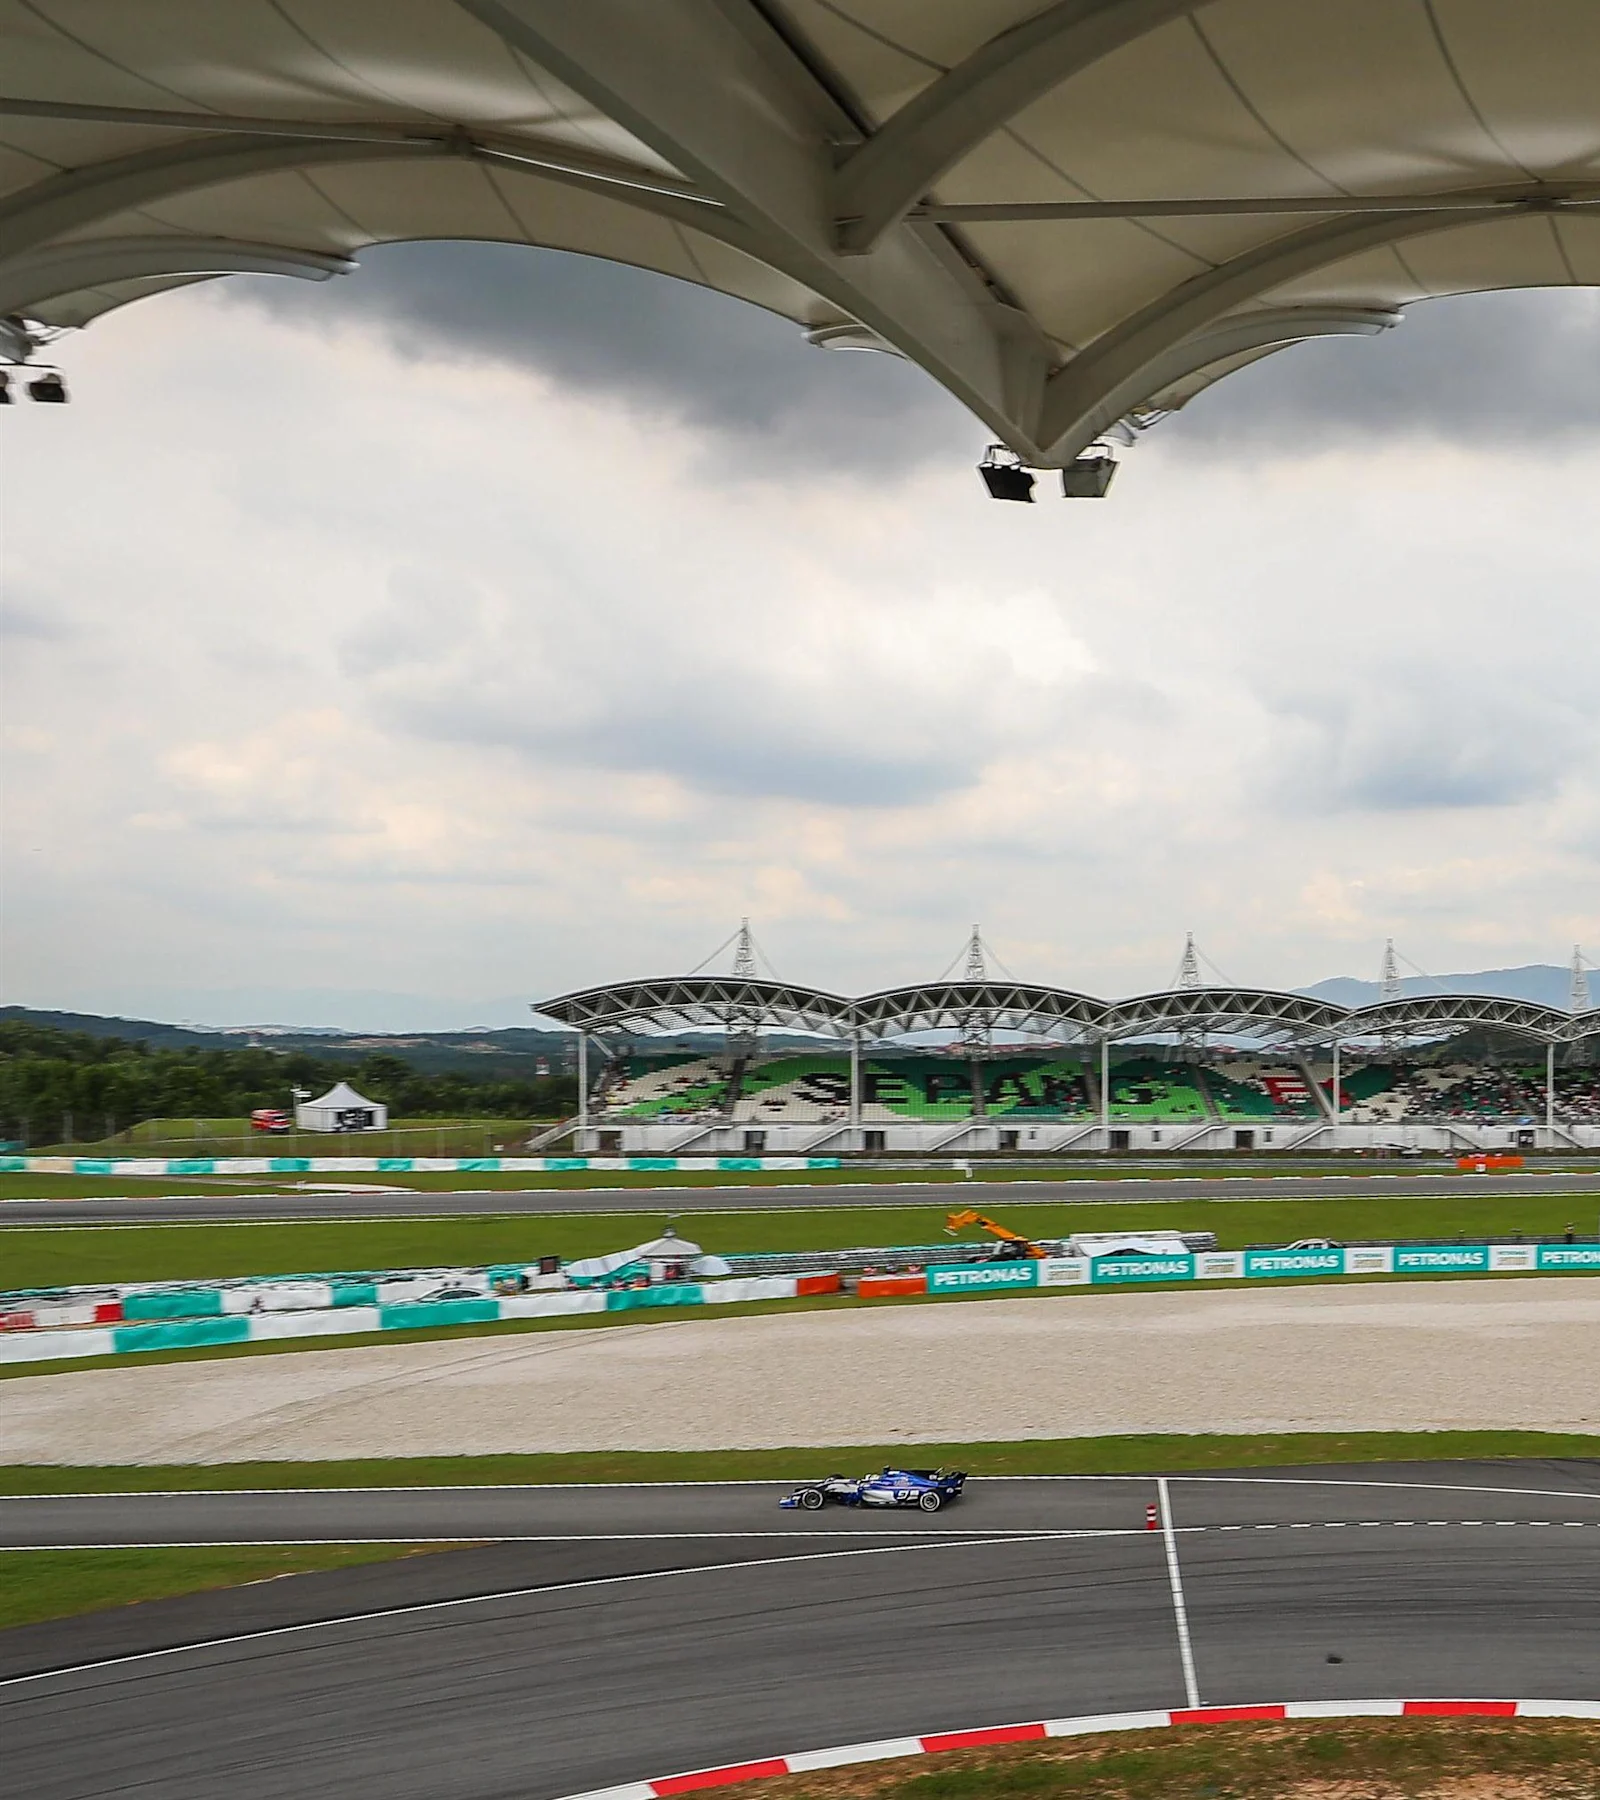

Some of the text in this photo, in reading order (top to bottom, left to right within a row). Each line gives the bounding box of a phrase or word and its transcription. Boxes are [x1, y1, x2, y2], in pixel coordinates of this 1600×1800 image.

[793, 1072, 1170, 1106] SEPANG
[1250, 1255, 1338, 1270] PETRONAS
[1398, 1252, 1484, 1266] PETRONAS
[1097, 1261, 1189, 1276] PETRONAS
[934, 1268, 1032, 1286] PETRONAS
